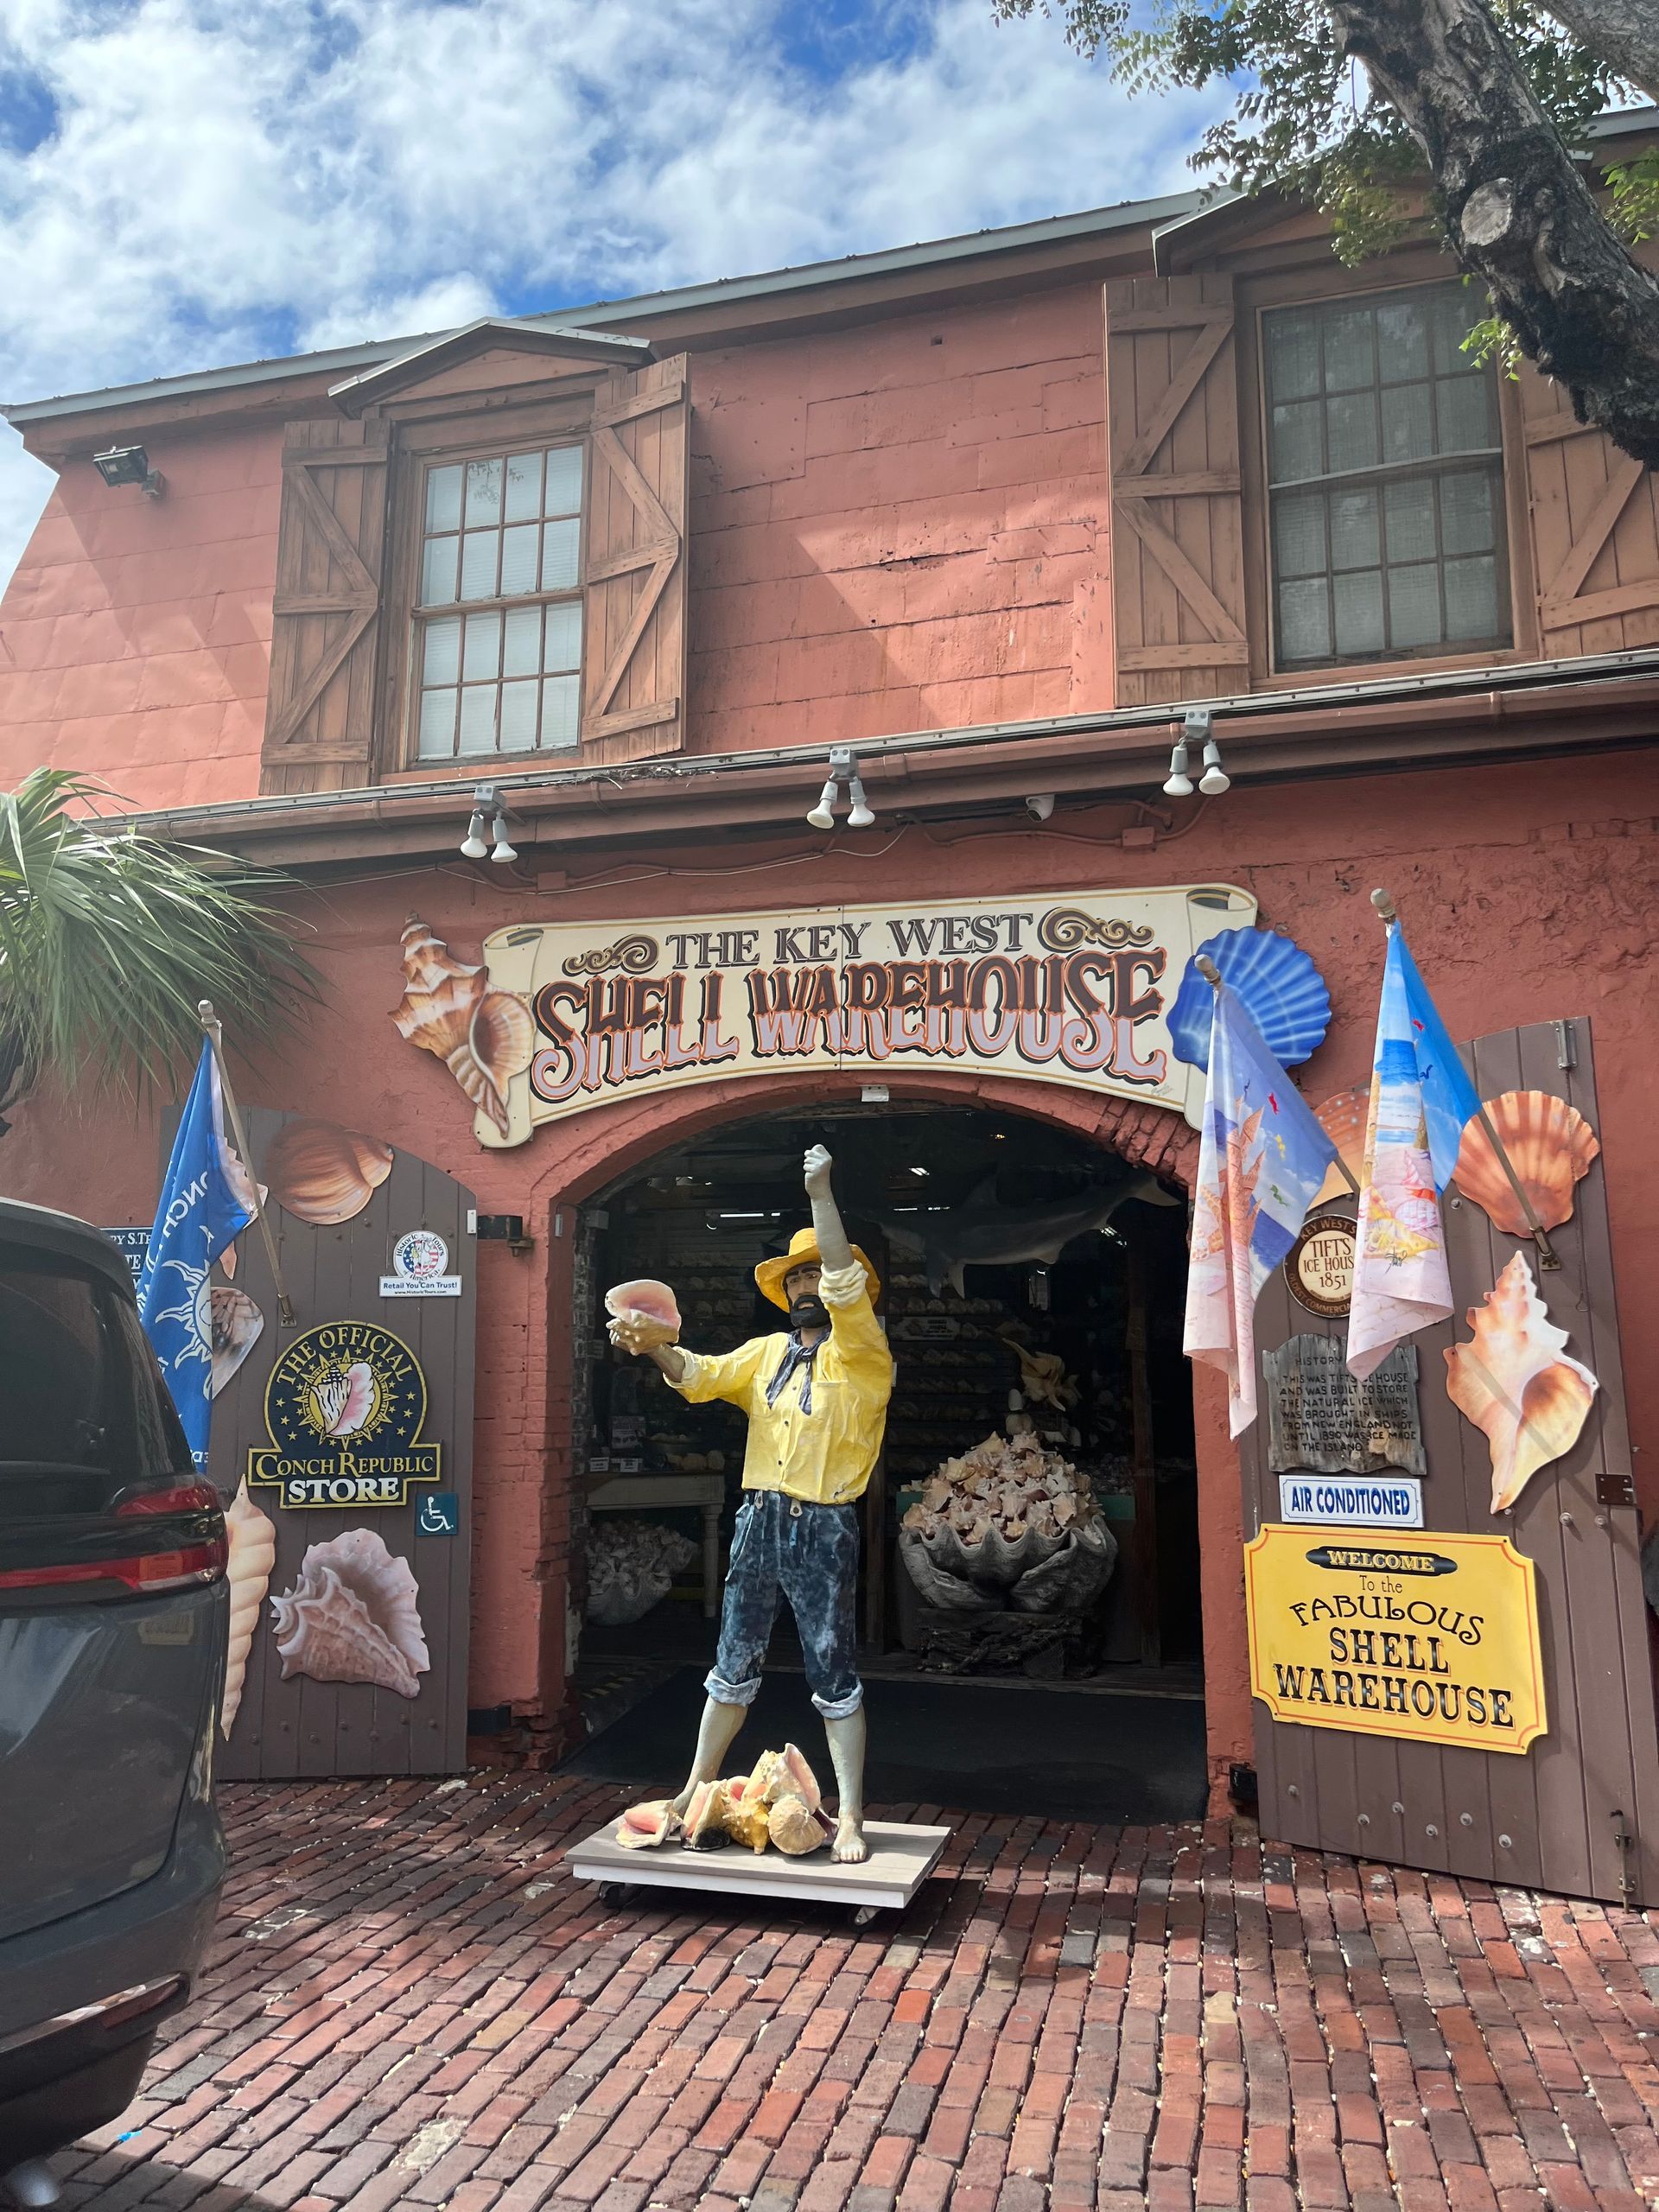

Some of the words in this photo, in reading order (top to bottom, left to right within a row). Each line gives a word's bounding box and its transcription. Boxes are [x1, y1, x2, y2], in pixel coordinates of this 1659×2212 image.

[664, 930, 760, 969] THE
[773, 921, 872, 964] KEY
[886, 912, 1033, 957] WEST
[530, 970, 740, 1103] SHELL
[743, 947, 1167, 1086] WAREHOUSE
[1300, 1224, 1318, 1241] KEY
[1304, 1259, 1320, 1273] ICE
[1324, 1256, 1355, 1271] HOUS
[1319, 1272, 1347, 1290] 1851
[276, 1341, 317, 1385] THE
[319, 1327, 413, 1382] OFFICIAL
[1295, 1356, 1343, 1366] HISTORY
[1282, 1375, 1305, 1383] THIS
[1306, 1375, 1326, 1383] WAS
[1376, 1372, 1408, 1382] HOUSE
[1279, 1386, 1303, 1396] AND
[1306, 1385, 1327, 1395] WAS
[1331, 1384, 1357, 1395] BUILT
[1362, 1385, 1374, 1394] TO
[1376, 1384, 1408, 1394] STORE
[1281, 1398, 1300, 1408] THE
[1303, 1397, 1355, 1408] NATURAL
[1358, 1396, 1373, 1406] ICE
[1376, 1396, 1408, 1405] WHICH
[1281, 1410, 1302, 1419] WAS
[1305, 1409, 1355, 1419] BROUGHT
[1374, 1409, 1408, 1418] SHIPS
[1282, 1421, 1310, 1430] FROM
[1339, 1420, 1391, 1429] ENGLAND
[1392, 1421, 1413, 1430] NOT
[1282, 1432, 1315, 1440] UNTIL
[1344, 1431, 1367, 1440] WAS
[1388, 1431, 1417, 1440] MADE
[1284, 1442, 1299, 1451] ON
[1301, 1442, 1320, 1452] THE
[1324, 1441, 1363, 1452] ISLAND
[288, 1477, 400, 1503] STORE
[1291, 1485, 1313, 1512] AIR
[1316, 1486, 1410, 1516] CONDITIONED
[1326, 1550, 1435, 1572] WELCOME
[1359, 1574, 1375, 1592] To
[1381, 1576, 1403, 1593] the
[1288, 1595, 1484, 1646] FABULOUS
[1329, 1626, 1451, 1676] SHELL
[1273, 1663, 1516, 1731] WAREHOUSE
